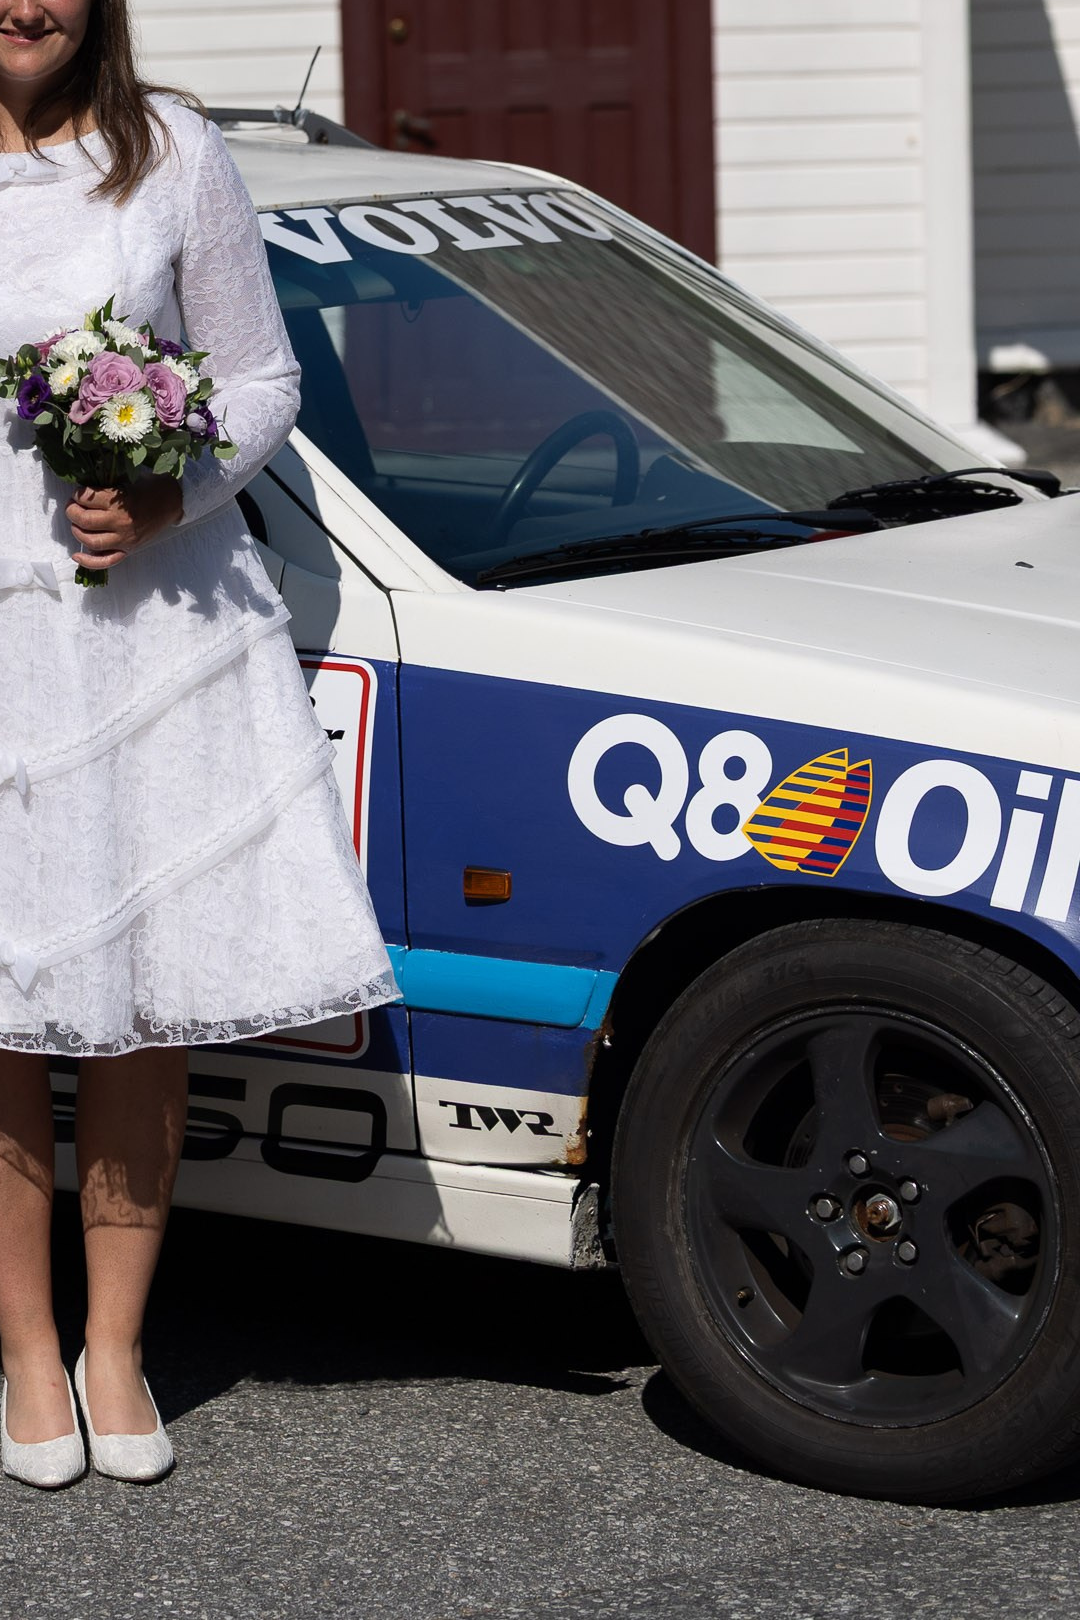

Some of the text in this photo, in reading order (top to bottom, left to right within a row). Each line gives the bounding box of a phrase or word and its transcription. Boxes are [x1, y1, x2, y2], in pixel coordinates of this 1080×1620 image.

[258, 193, 615, 264] VOLVO
[567, 713, 1080, 923] Q8 Oil
[438, 1100, 564, 1137] TWR
